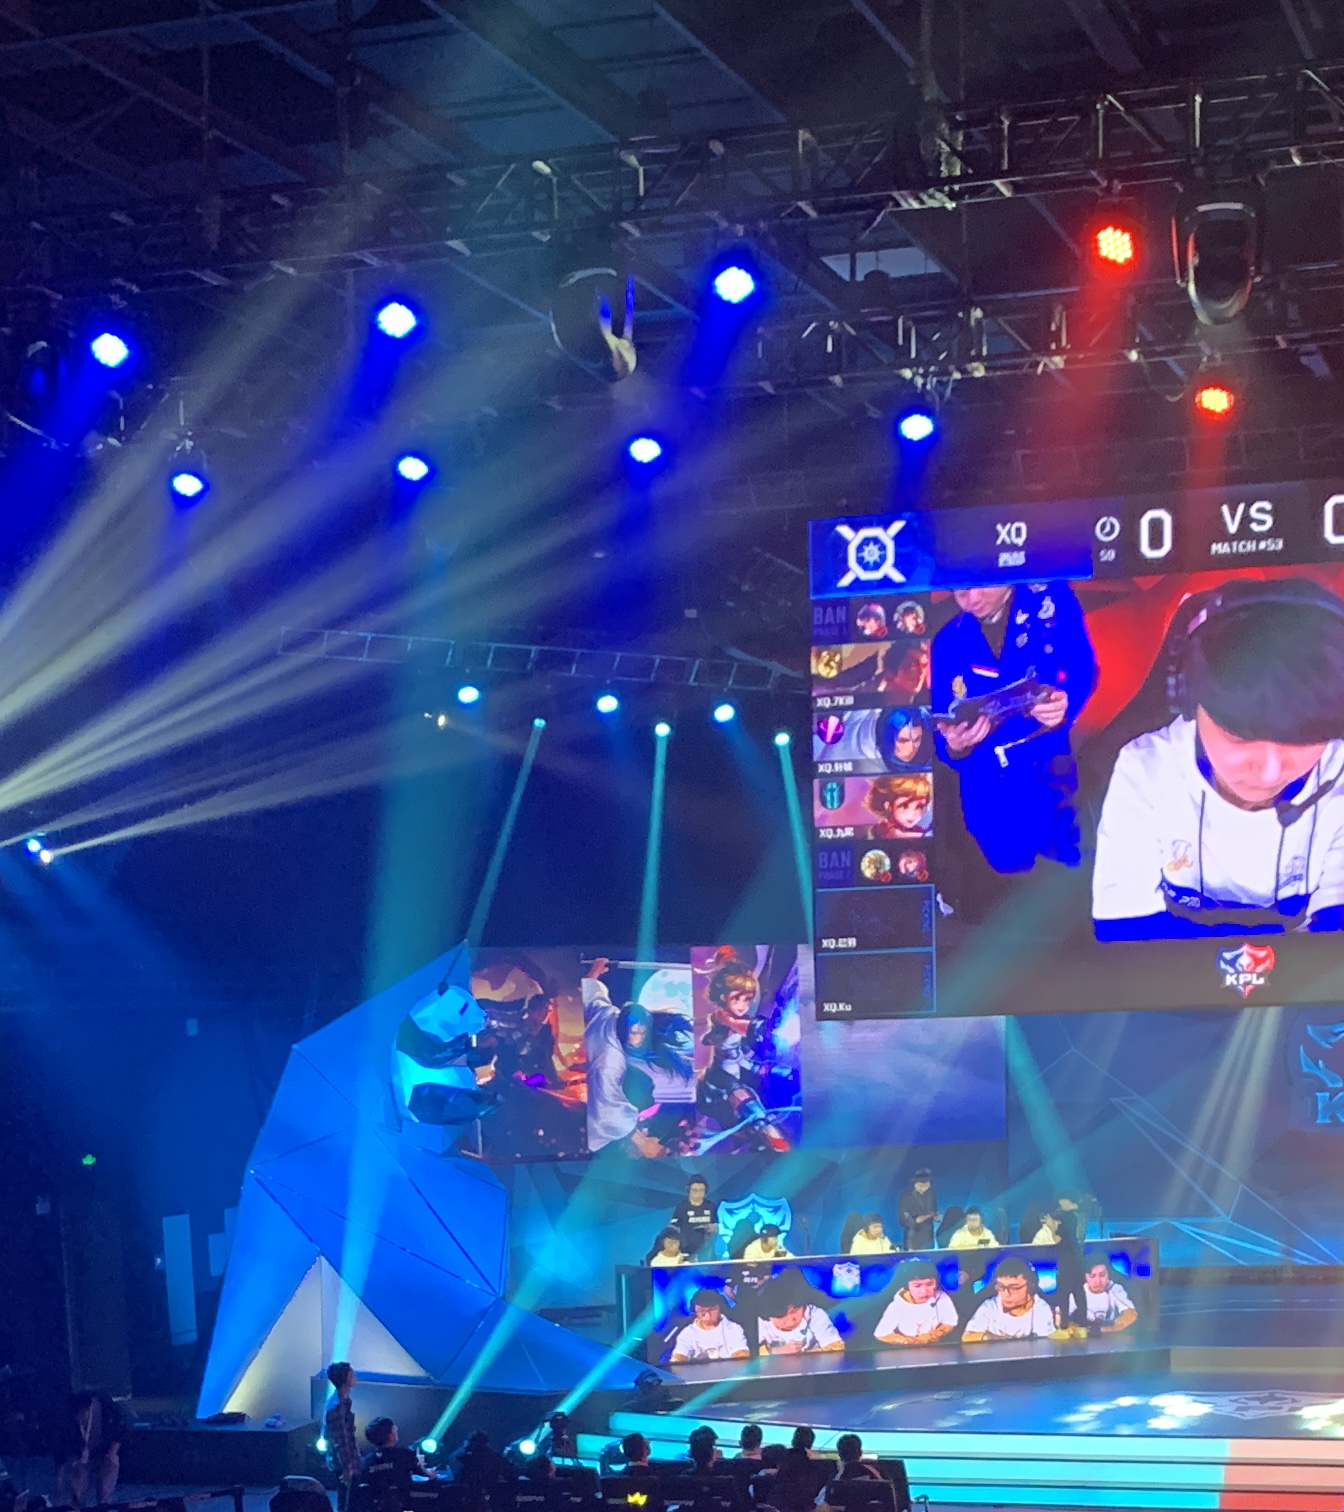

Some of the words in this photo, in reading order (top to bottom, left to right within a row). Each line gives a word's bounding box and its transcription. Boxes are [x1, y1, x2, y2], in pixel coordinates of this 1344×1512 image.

[1220, 500, 1274, 535] VS
[995, 521, 1028, 547] XQ
[1138, 508, 1173, 560] 0
[1210, 540, 1256, 556] MATCH
[813, 605, 848, 625] BAN
[818, 850, 852, 869] BAN
[1225, 973, 1265, 986] KPL
